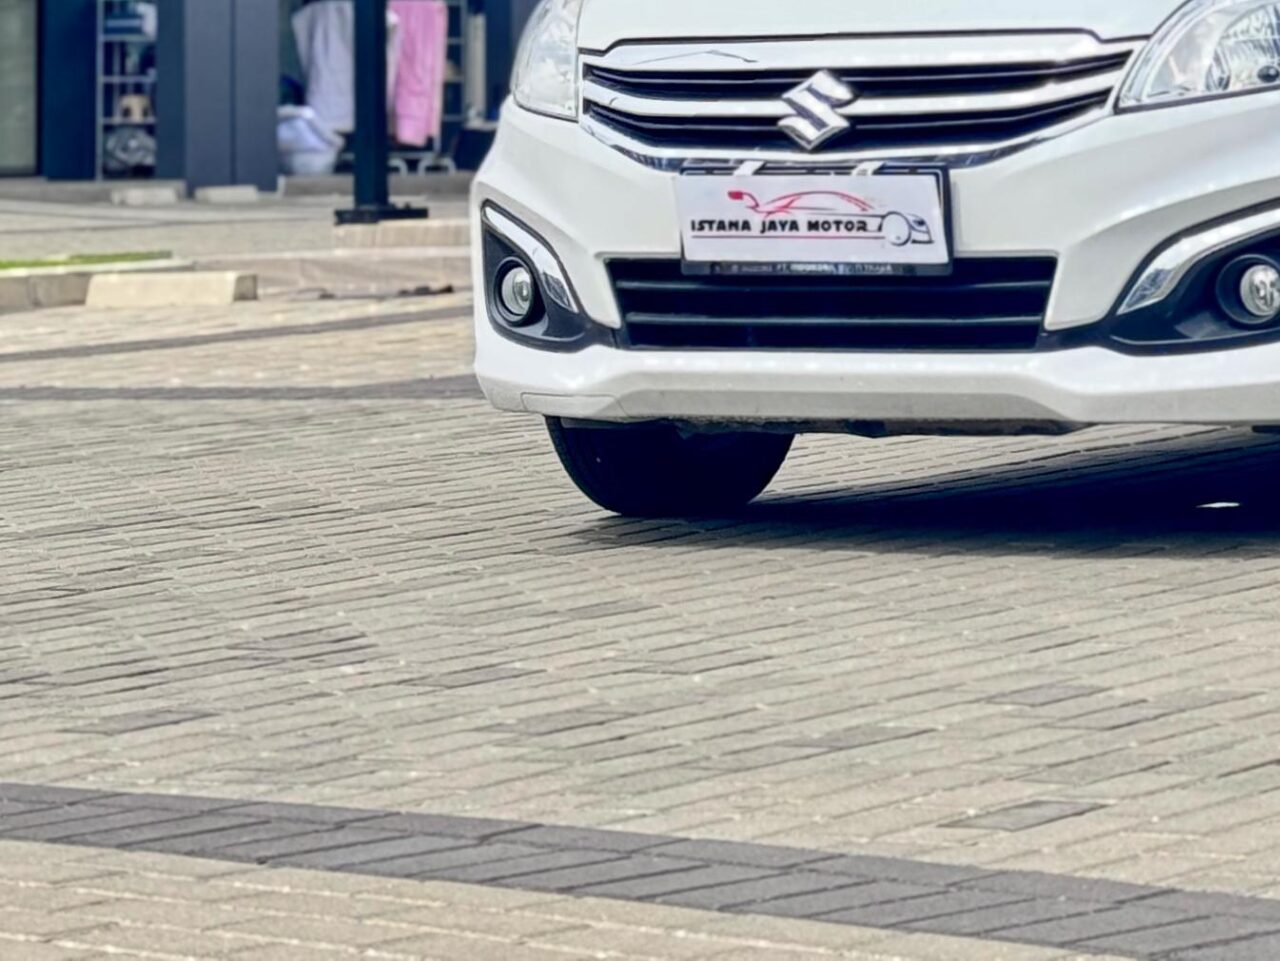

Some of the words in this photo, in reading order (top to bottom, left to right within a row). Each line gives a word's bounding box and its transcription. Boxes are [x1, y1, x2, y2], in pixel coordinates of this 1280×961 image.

[691, 219, 752, 232] ISTANA
[760, 219, 799, 234] JAYA
[807, 220, 868, 232] MOTOR
